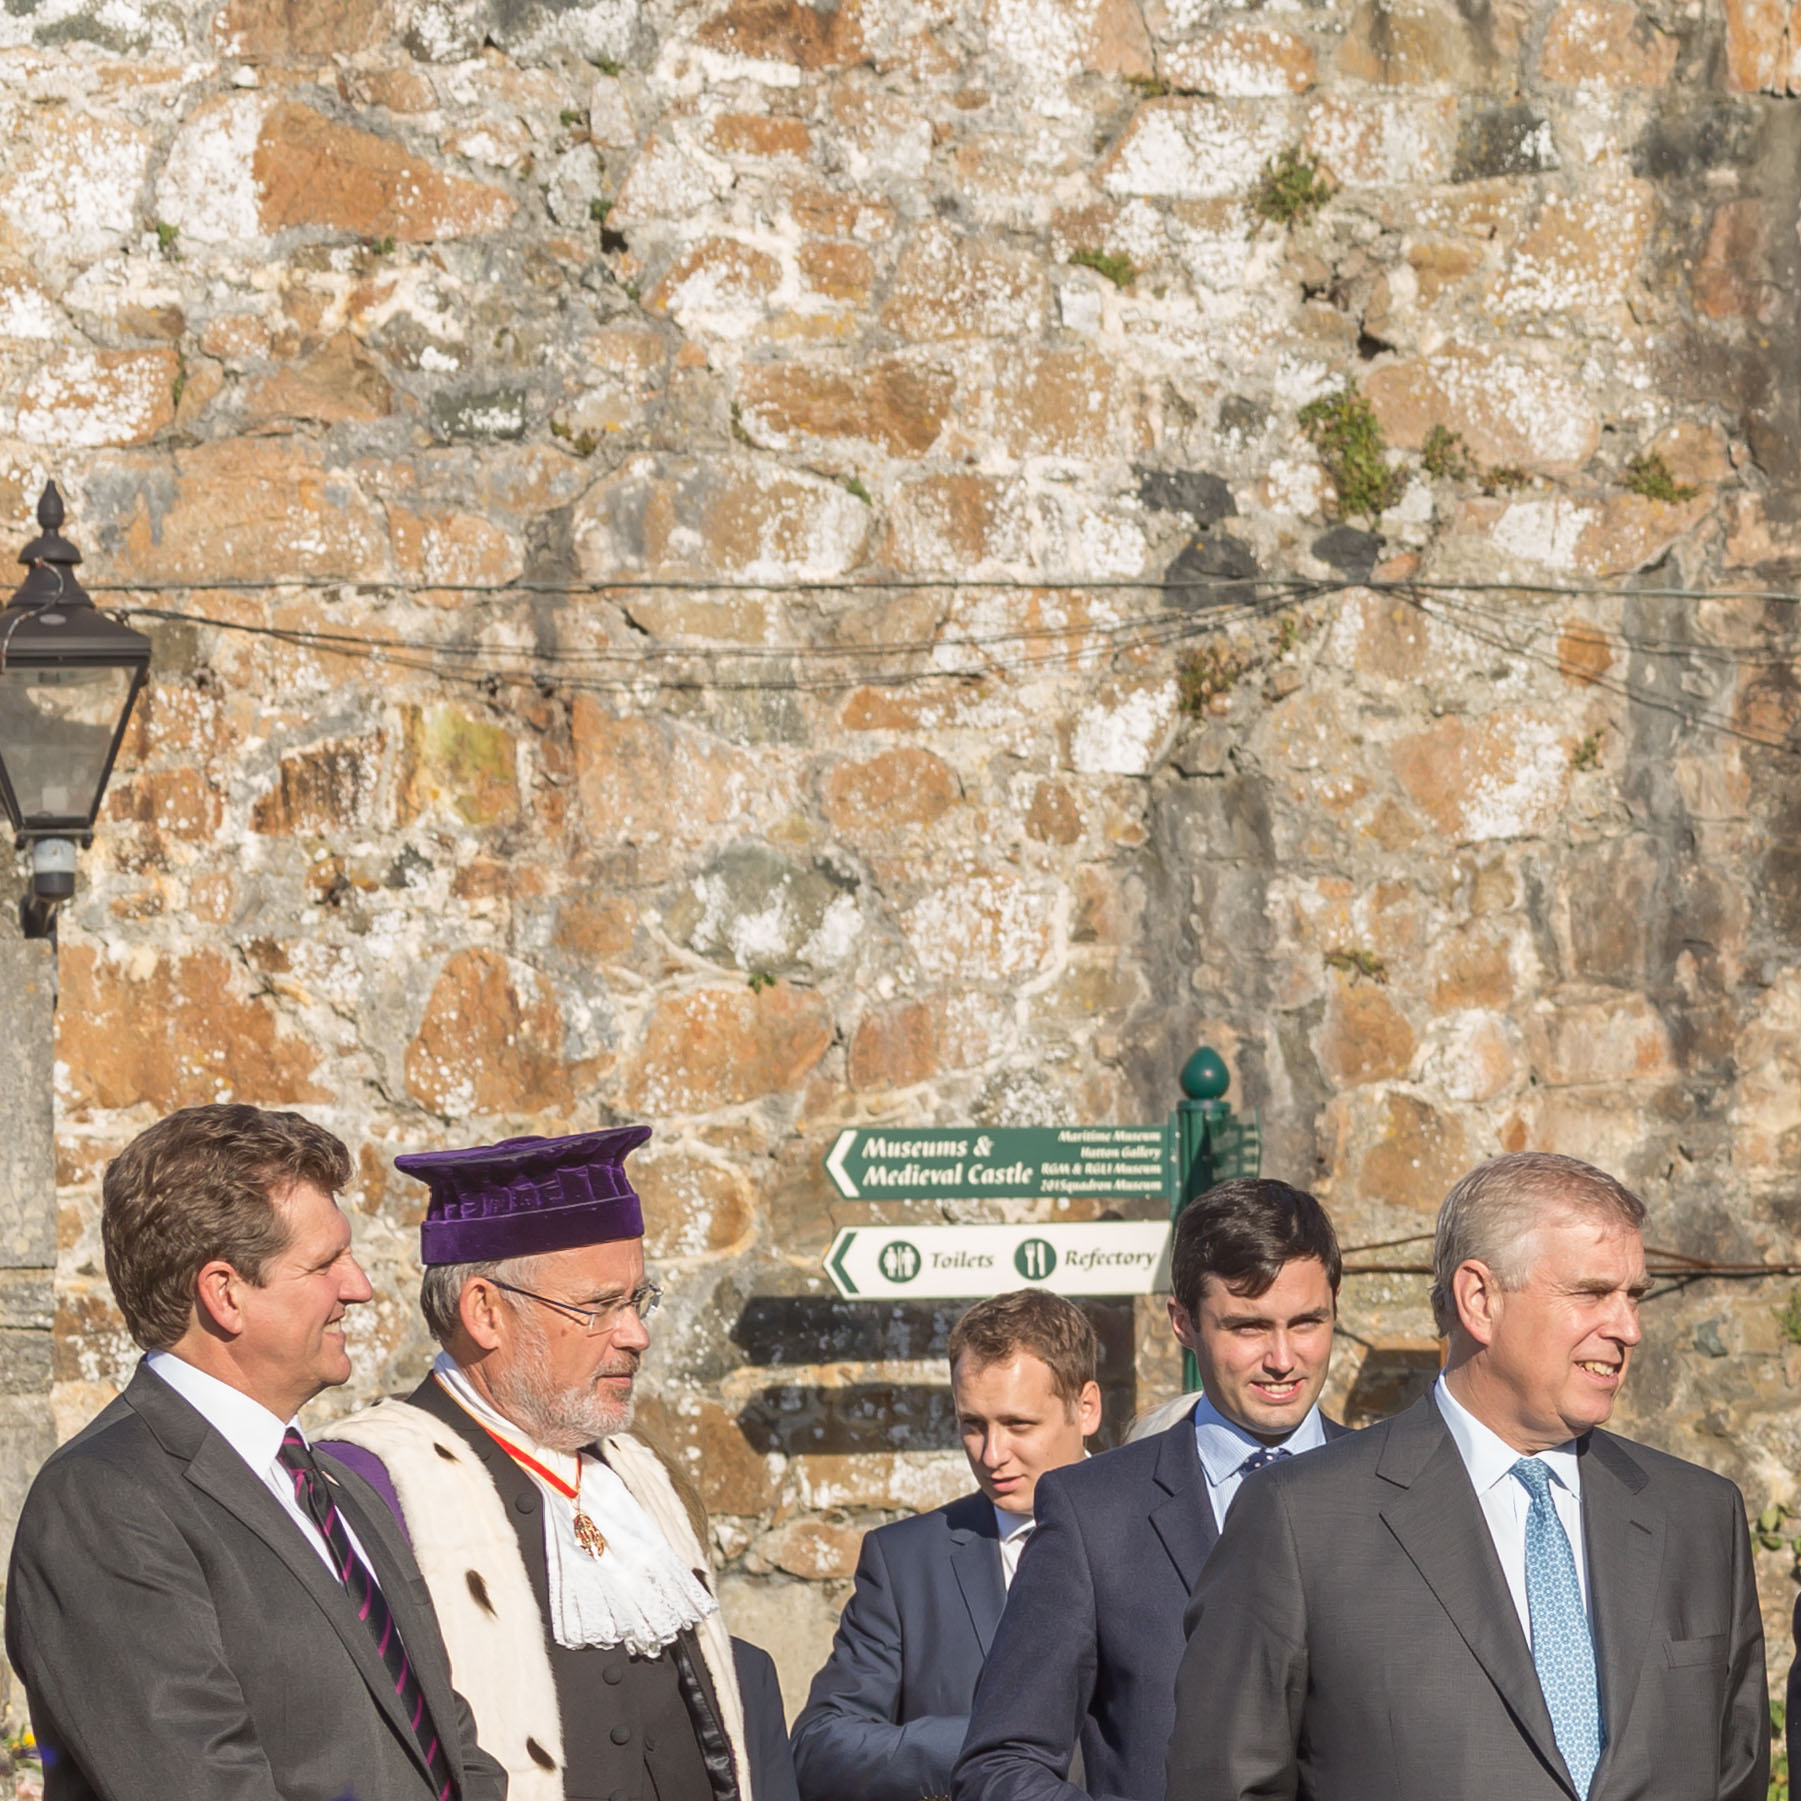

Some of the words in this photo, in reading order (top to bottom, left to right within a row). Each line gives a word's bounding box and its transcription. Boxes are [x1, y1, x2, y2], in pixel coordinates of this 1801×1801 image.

[1057, 1130, 1112, 1142] Maritime
[1112, 1130, 1162, 1142] Museum
[862, 1138, 968, 1158] Museums
[973, 1135, 994, 1157] &
[1080, 1147, 1119, 1159] Hatton
[1121, 1146, 1162, 1161] Gallery
[862, 1162, 963, 1186] Medieval
[968, 1161, 1033, 1185] Castle
[1041, 1162, 1070, 1175] RGM
[1072, 1163, 1082, 1175] &
[1084, 1162, 1113, 1175] RGLI
[1113, 1163, 1162, 1175] Museum
[1113, 1179, 1162, 1191] Museum
[931, 1252, 993, 1269] Toilets
[1065, 1249, 1155, 1271] Refectory
